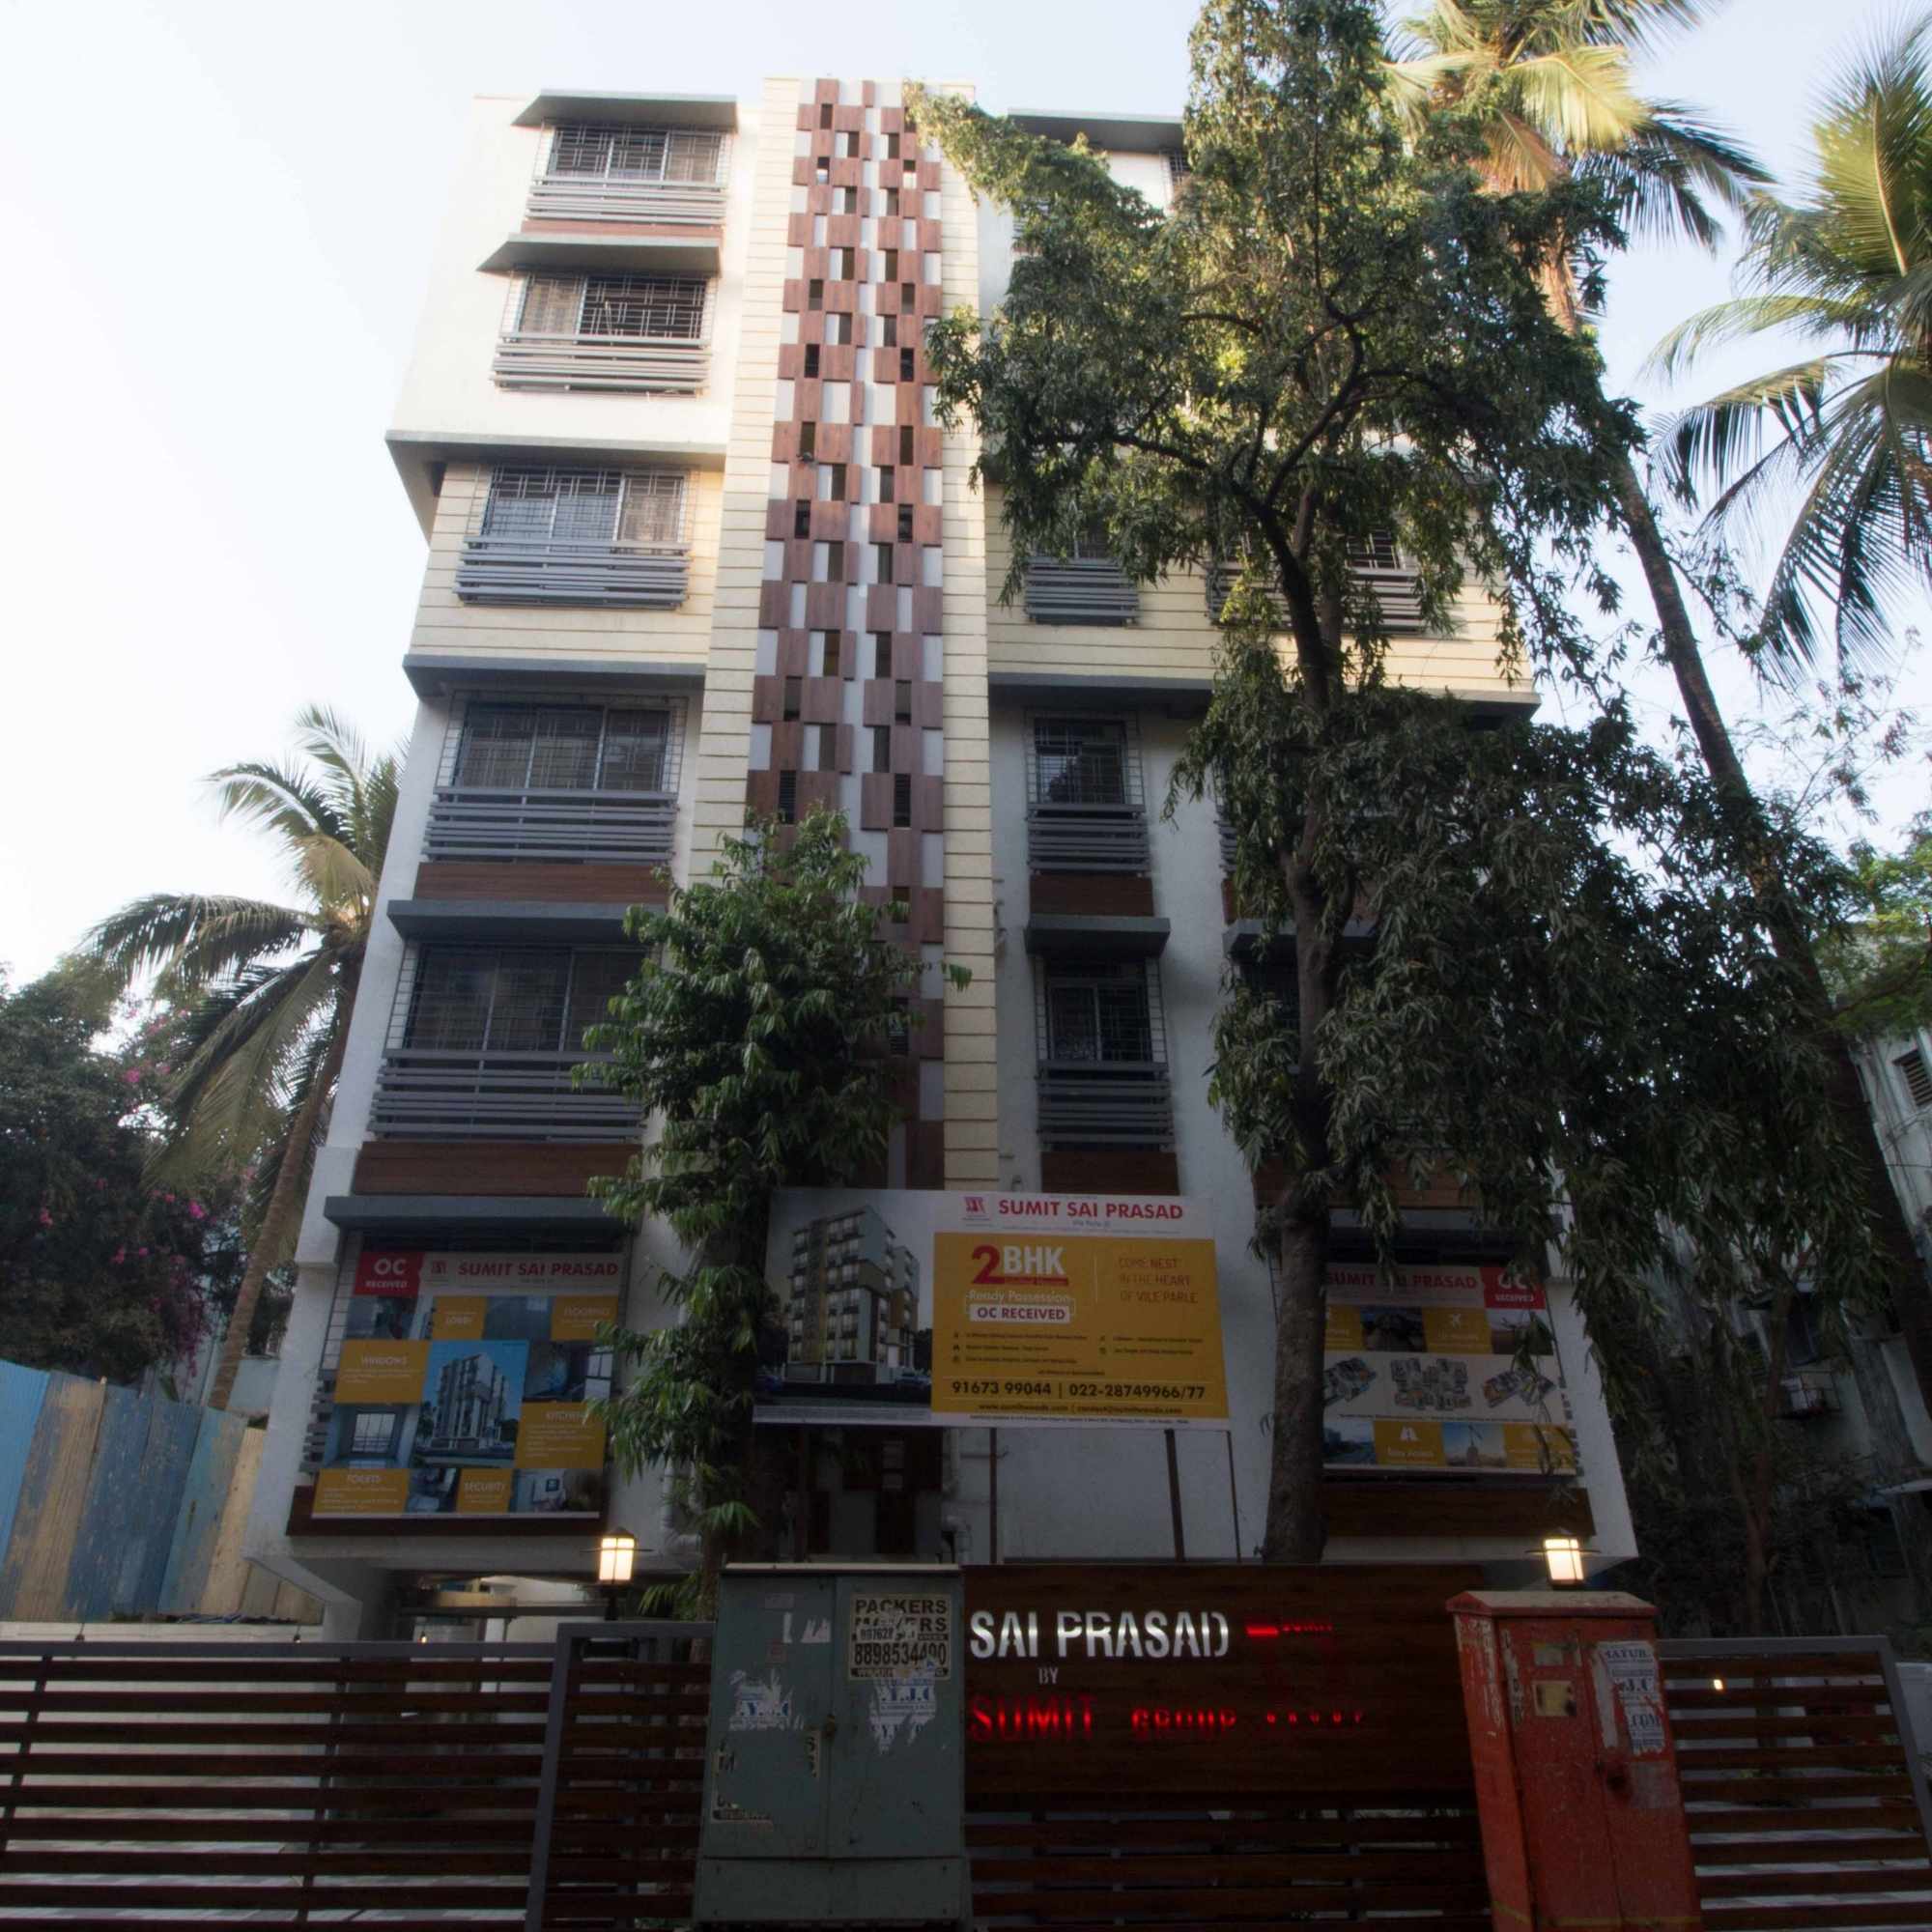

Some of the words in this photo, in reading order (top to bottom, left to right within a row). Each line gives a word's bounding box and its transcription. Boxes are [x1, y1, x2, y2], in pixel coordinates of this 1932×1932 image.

[999, 1199, 1060, 1216] SUMIT
[1067, 1202, 1098, 1218] SAI
[1106, 1203, 1183, 1220] PRASAD
[374, 1258, 408, 1276] OC
[457, 1262, 514, 1277] SUMIT
[518, 1262, 545, 1276] SAI
[551, 1262, 619, 1277] PRASAD
[365, 1280, 409, 1290] RECEIVED
[1154, 1275, 1190, 1287] HEART
[1412, 1274, 1477, 1290] PRASAD
[978, 1307, 997, 1320] OC
[1001, 1308, 1066, 1321] RECEIVED
[952, 1381, 999, 1395] 91673
[1004, 1382, 1052, 1396] 99044
[1069, 1383, 1206, 1400] 022-28749966/77
[855, 1599, 948, 1614] PACKERS
[970, 1610, 1037, 1658] SAI
[1057, 1610, 1231, 1659] PRASAD
[1037, 1666, 1059, 1685] BY
[970, 1692, 1097, 1742] SUMIT
